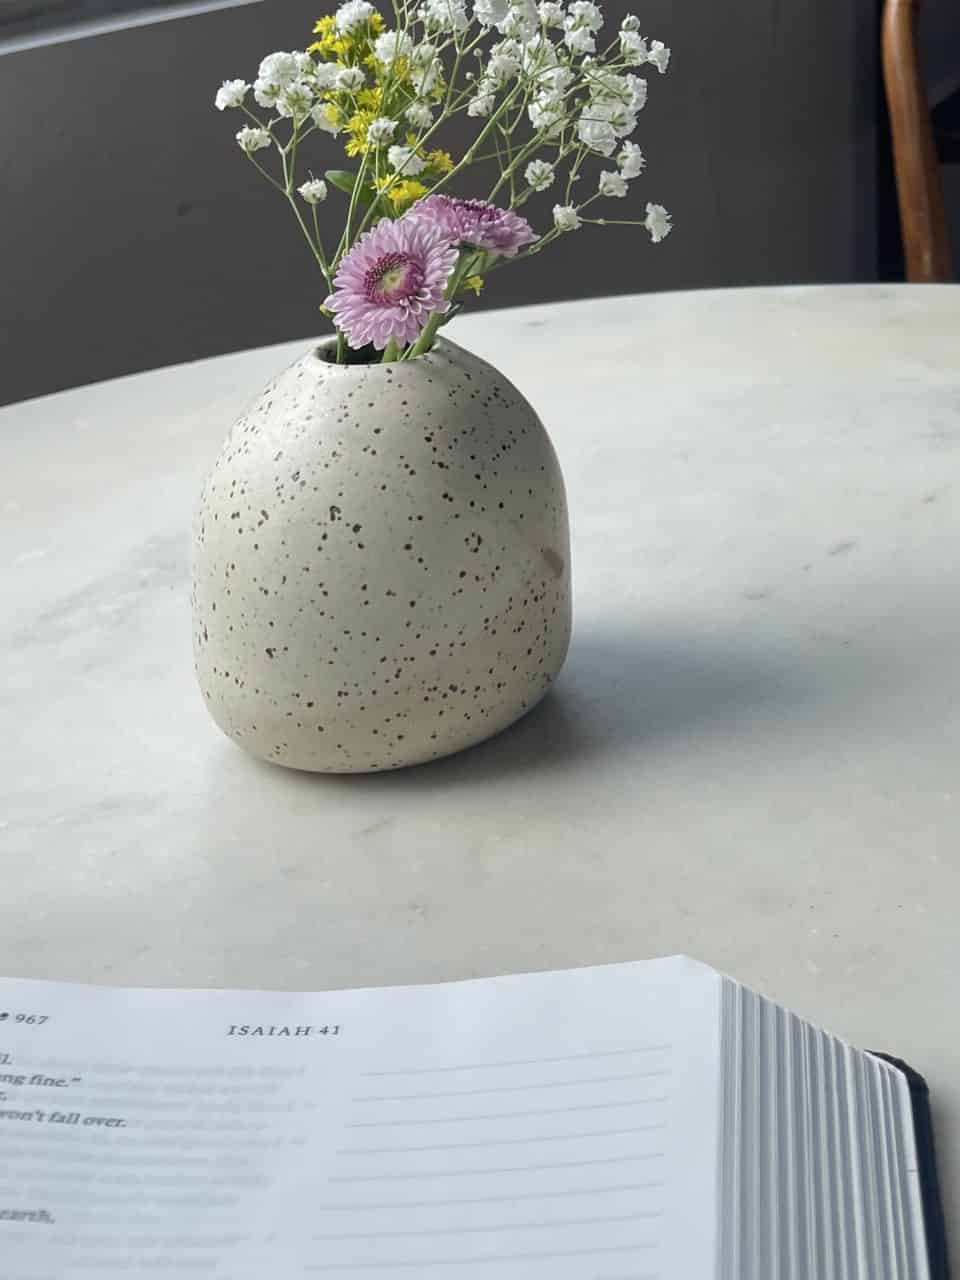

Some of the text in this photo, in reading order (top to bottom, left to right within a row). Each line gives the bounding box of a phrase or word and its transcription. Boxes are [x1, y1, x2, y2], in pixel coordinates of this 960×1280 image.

[15, 1014, 49, 1025] 967
[227, 1025, 340, 1036] ISAIAH 41
[0, 1074, 26, 1086] ng
[48, 1111, 80, 1125] fall
[82, 1117, 127, 1127] over.
